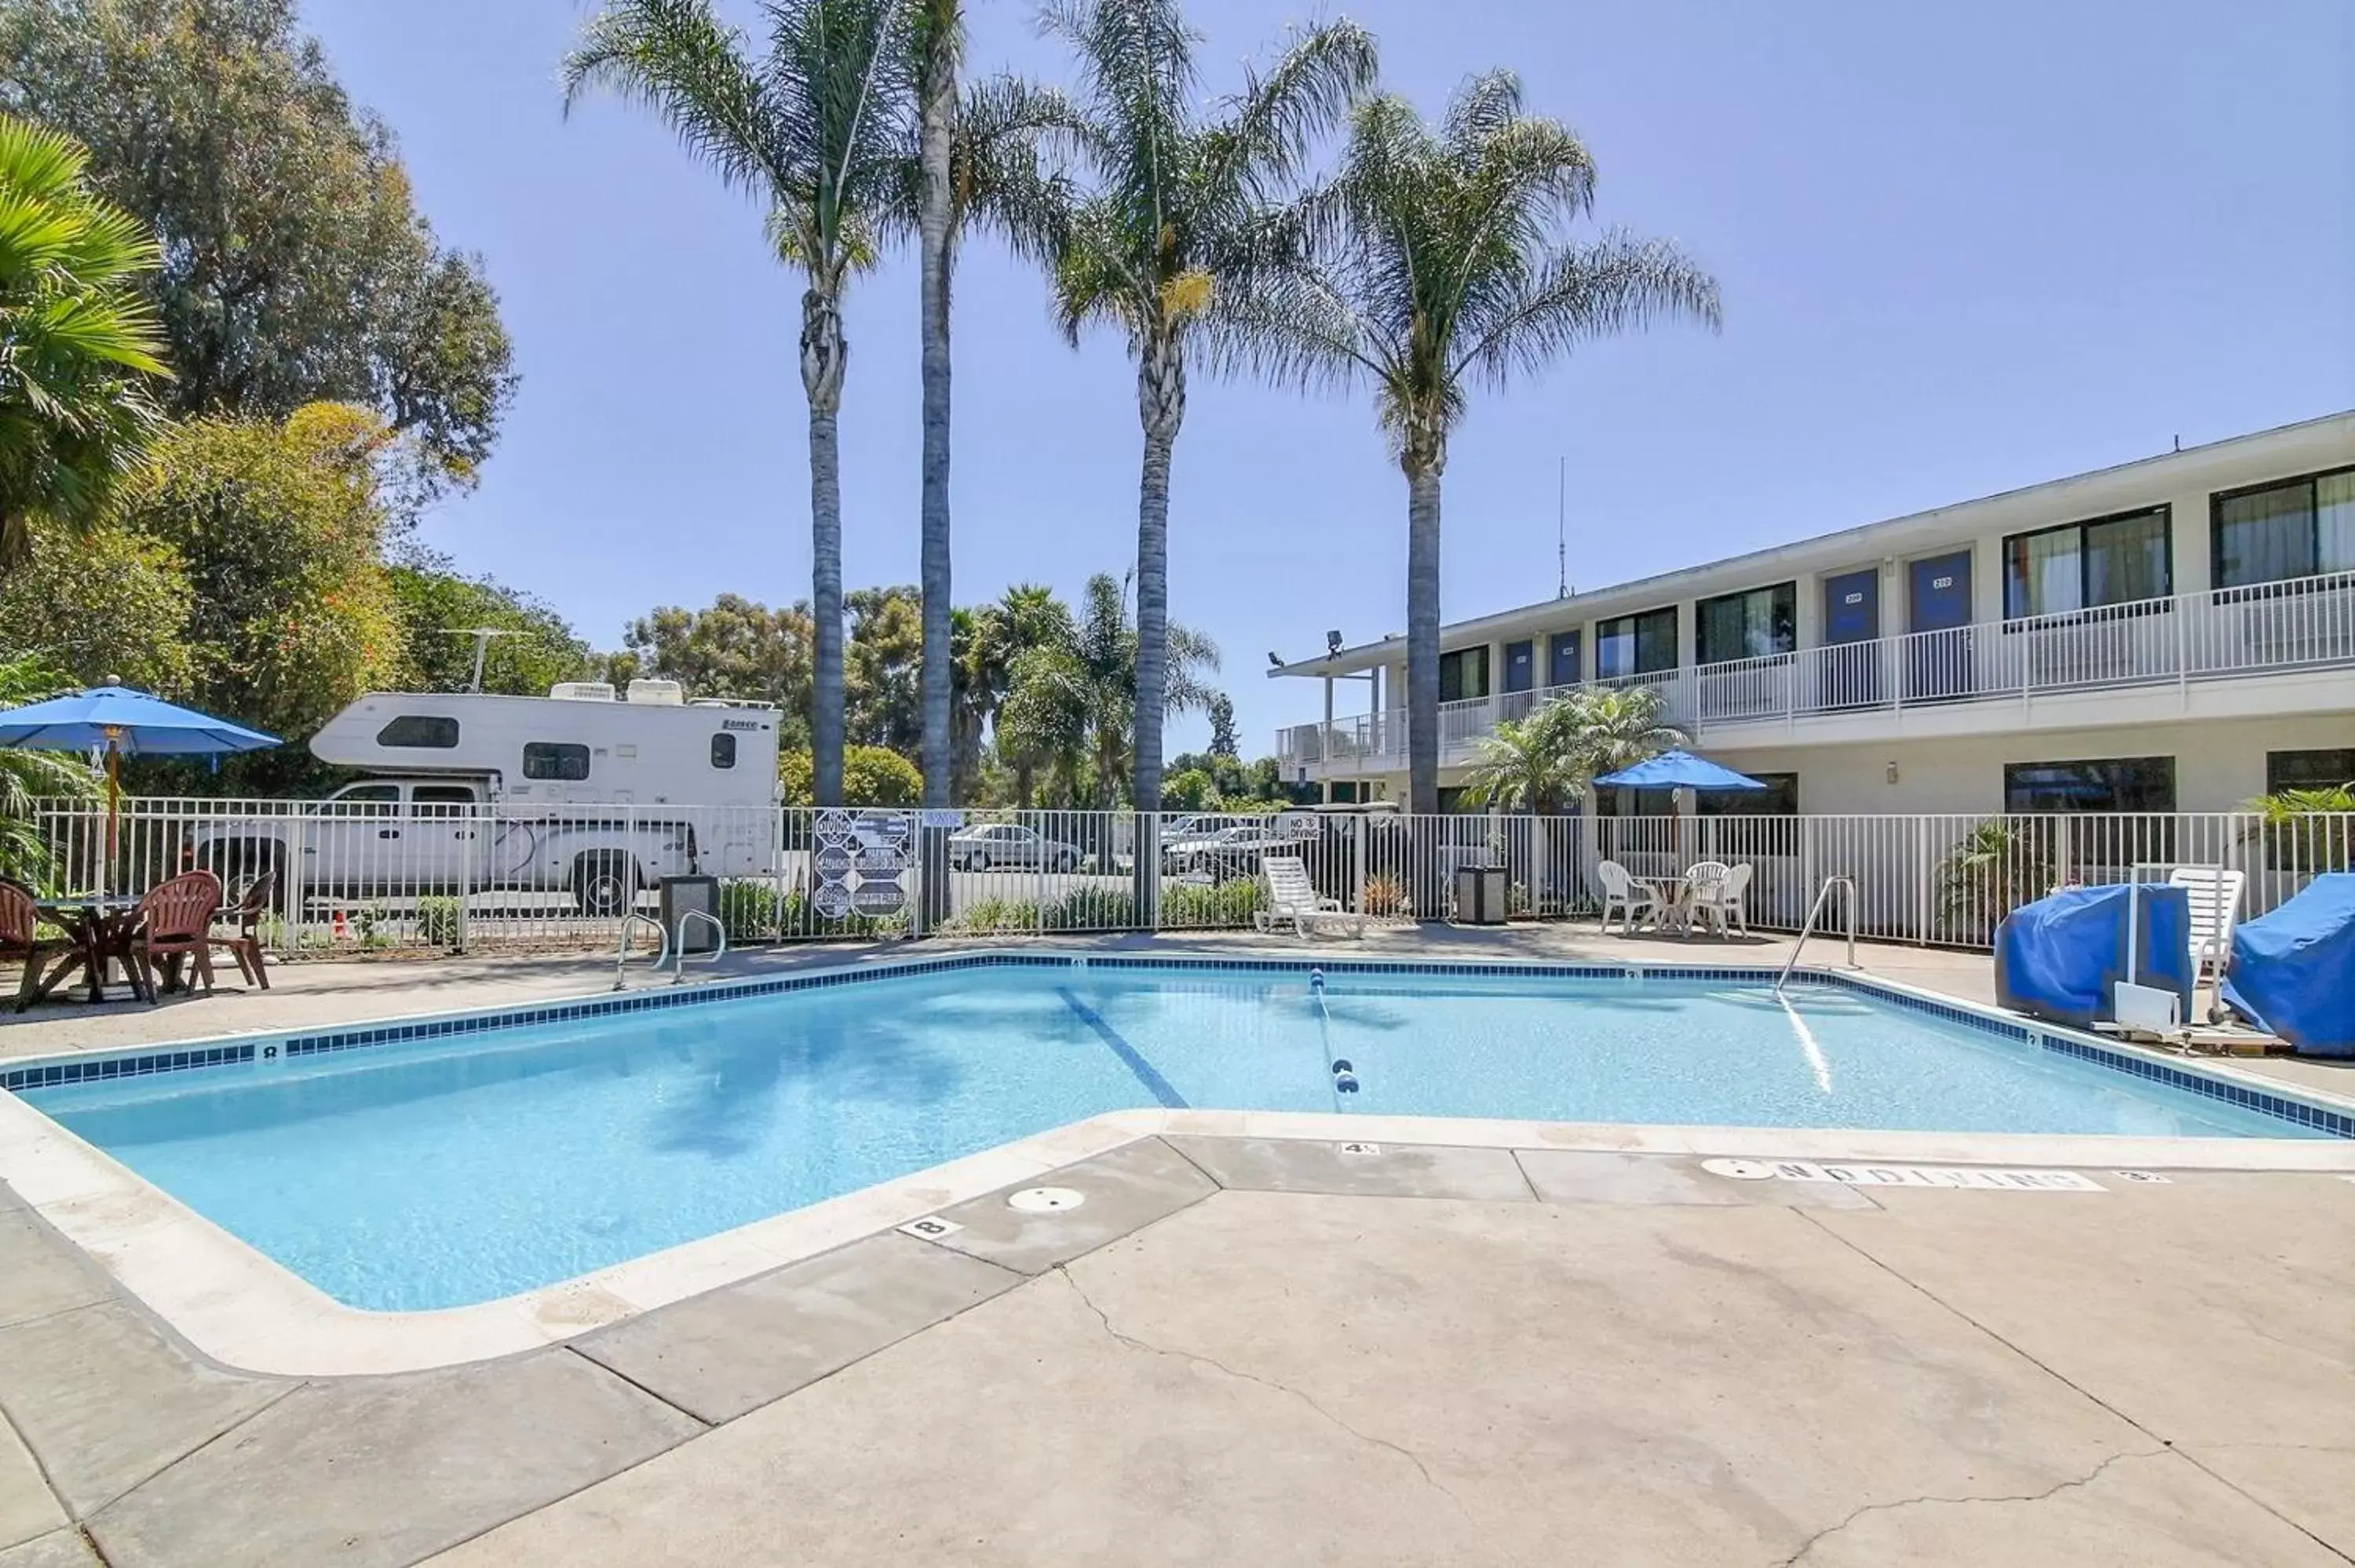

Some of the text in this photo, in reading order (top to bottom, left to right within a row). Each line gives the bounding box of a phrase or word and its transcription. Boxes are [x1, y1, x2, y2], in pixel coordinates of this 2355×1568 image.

[818, 821, 852, 833] DIVING
[1290, 819, 1303, 828] NO
[1290, 829, 1319, 838] DIVING
[1867, 1169, 2082, 1187] DIVING
[914, 1221, 947, 1234] 8
